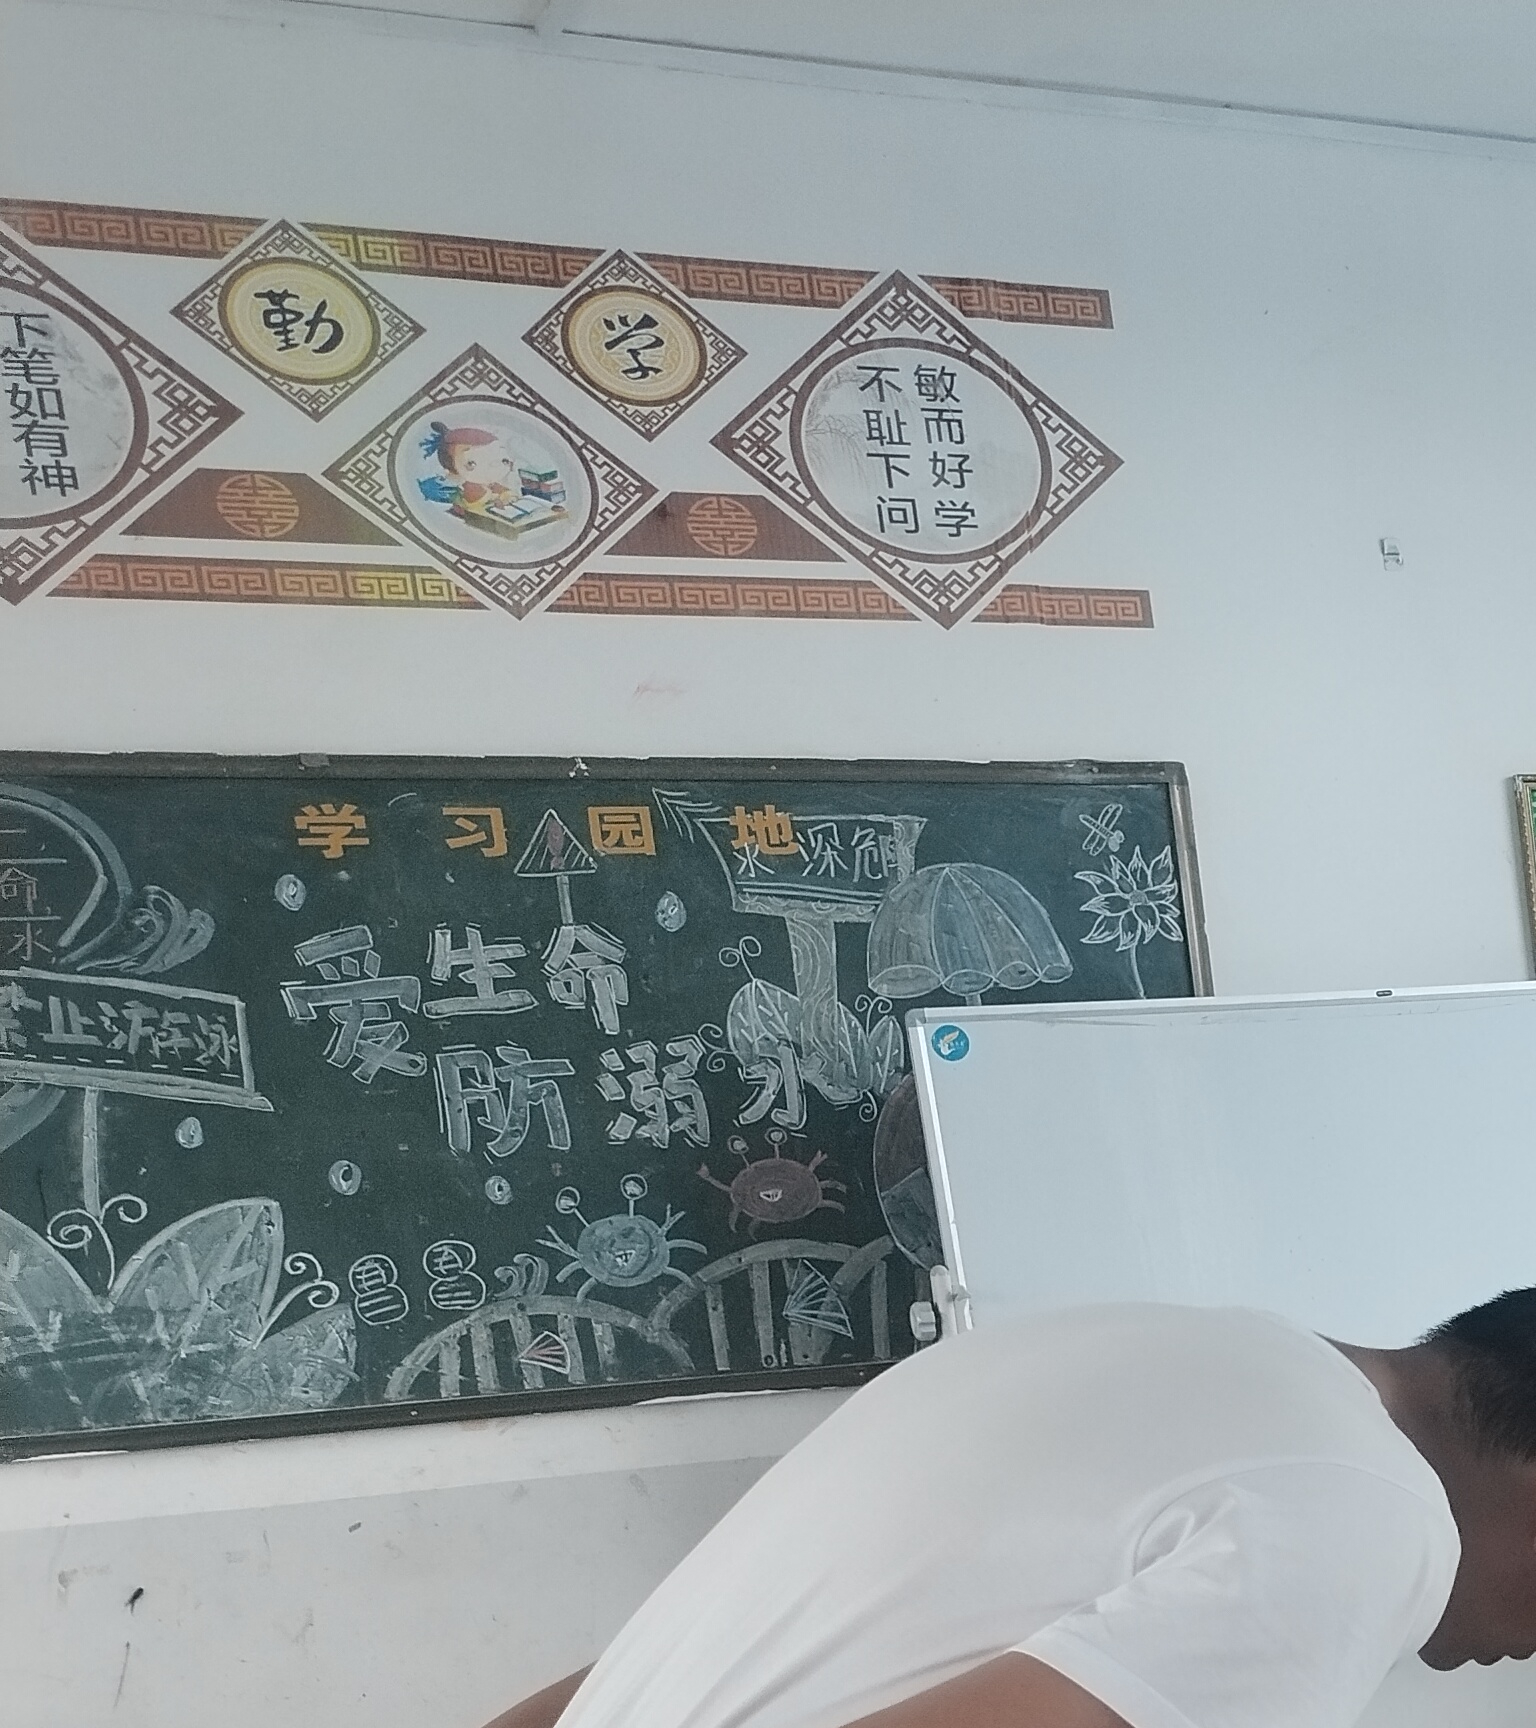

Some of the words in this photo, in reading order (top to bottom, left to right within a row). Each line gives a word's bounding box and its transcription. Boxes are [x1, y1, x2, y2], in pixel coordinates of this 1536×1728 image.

[253, 289, 345, 354] 勤
[602, 312, 665, 380] 学
[0, 311, 80, 497] 下笔如有神
[856, 364, 920, 534] 不耻下问
[913, 363, 979, 537] 敏而好学
[294, 803, 801, 859] 学习园地
